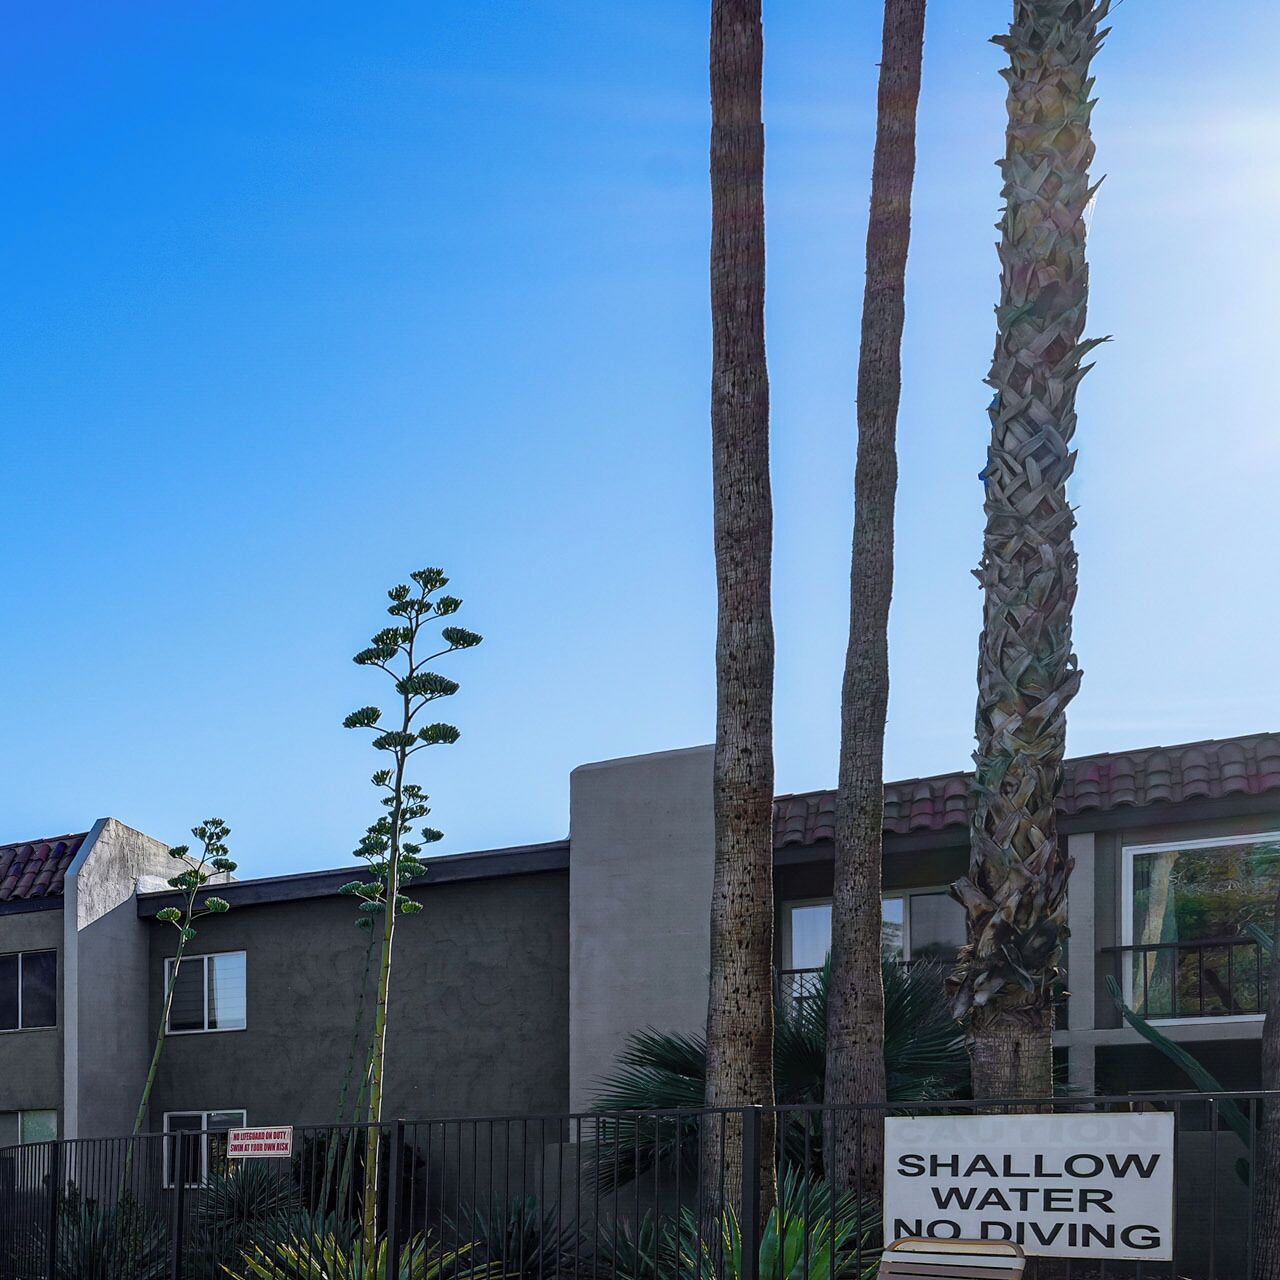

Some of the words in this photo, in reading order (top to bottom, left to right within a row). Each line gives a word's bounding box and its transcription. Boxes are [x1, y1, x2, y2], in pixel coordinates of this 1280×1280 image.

[233, 1132, 240, 1141] NO
[241, 1131, 265, 1140] LIFEGUARD
[265, 1131, 273, 1139] ON
[273, 1131, 287, 1139] DUTY
[891, 1119, 1157, 1145] CAUTION
[230, 1144, 244, 1152] SWIM
[244, 1143, 250, 1152] AT
[250, 1143, 263, 1151] YOUR
[263, 1143, 276, 1151] OWN
[276, 1142, 289, 1151] RISK
[896, 1153, 1161, 1179] SHALLOW
[931, 1187, 1116, 1214] WATER
[894, 1219, 961, 1240] NO
[980, 1220, 1161, 1250] DIVING
